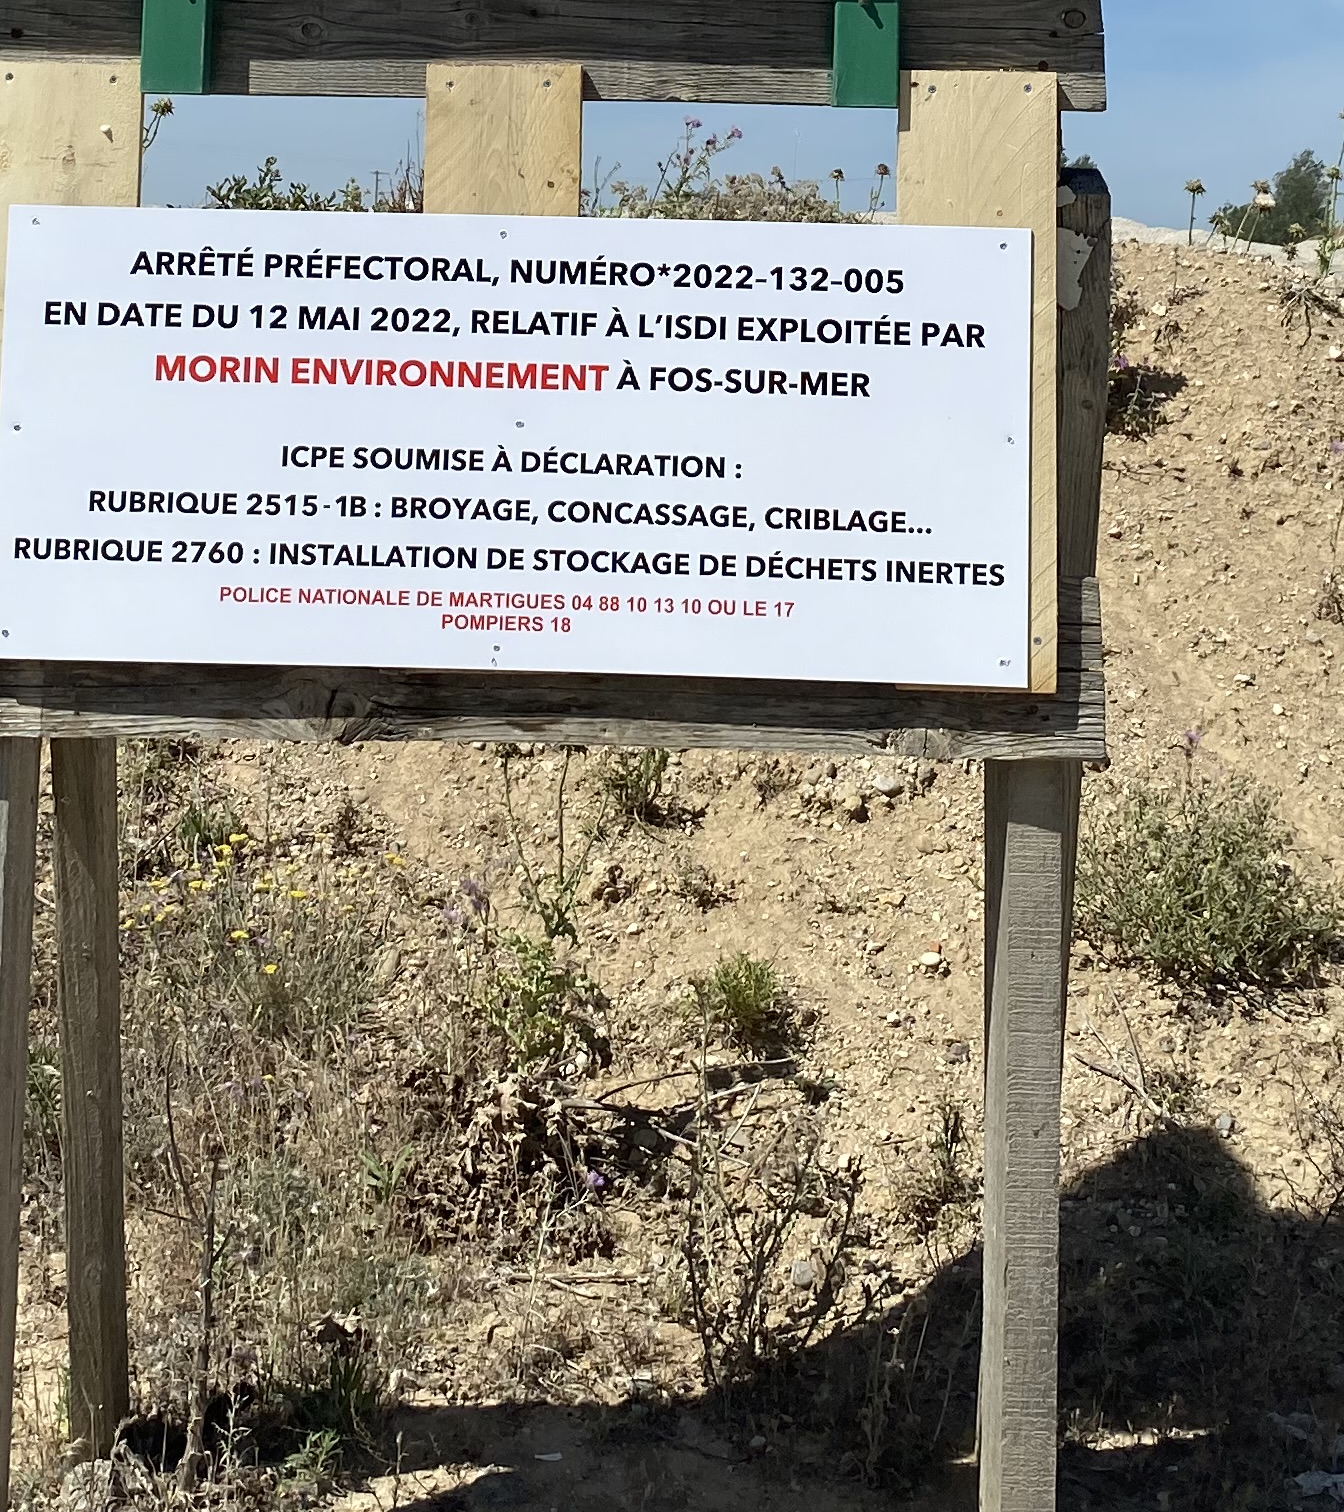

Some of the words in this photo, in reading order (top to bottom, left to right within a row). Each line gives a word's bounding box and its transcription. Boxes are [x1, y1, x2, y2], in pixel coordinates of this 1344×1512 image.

[129, 245, 254, 278] ARRÊTÉ
[264, 247, 500, 287] PRÉFECTORAL,
[44, 300, 87, 326] EN
[97, 301, 183, 328] DATE
[192, 303, 239, 329] DU
[249, 304, 288, 330] 12
[297, 305, 360, 331] MAI
[370, 306, 461, 338] 2022,
[471, 309, 598, 337] RELATIF
[604, 306, 630, 338] À
[737, 314, 911, 346] EXPLOITÉE
[921, 322, 986, 349] PAR
[155, 354, 280, 384] MORIN
[291, 357, 610, 392] ENVIRONNEMENT
[615, 358, 641, 391] À
[649, 366, 871, 398] FOS-SUR-MER
[281, 445, 345, 469] ICPE
[352, 446, 485, 472] SOUMISE
[490, 444, 513, 473] À
[520, 445, 726, 479] DÉCLARATION
[88, 489, 238, 515] RUBRIQUE
[246, 493, 367, 518] 2515-1B
[390, 496, 539, 526] BROYAGE,
[547, 500, 756, 532] CONCASSAGE,
[764, 506, 933, 535] CRIBLAGE...
[13, 537, 163, 563] RUBRIQUE
[171, 540, 244, 565] 2760
[269, 542, 478, 570] INSTALLATION
[486, 547, 525, 571] DE
[532, 548, 690, 576] STOCKAGE
[698, 553, 737, 577] DE
[745, 550, 877, 582] DÉCHETS
[886, 560, 1005, 587] INERTES
[219, 586, 293, 604] POLICE
[298, 588, 411, 606] NATIONALE
[416, 590, 443, 607] DE
[449, 591, 566, 610] MARTIGUES
[571, 594, 593, 611] 04
[598, 595, 620, 612] 88
[626, 596, 647, 613] 10
[653, 597, 675, 614] 13
[681, 598, 702, 615] 10
[707, 599, 736, 616] OU
[743, 600, 767, 617] LE
[774, 601, 795, 618] 17
[441, 613, 544, 632] POMPIERS
[550, 616, 571, 633] 18
